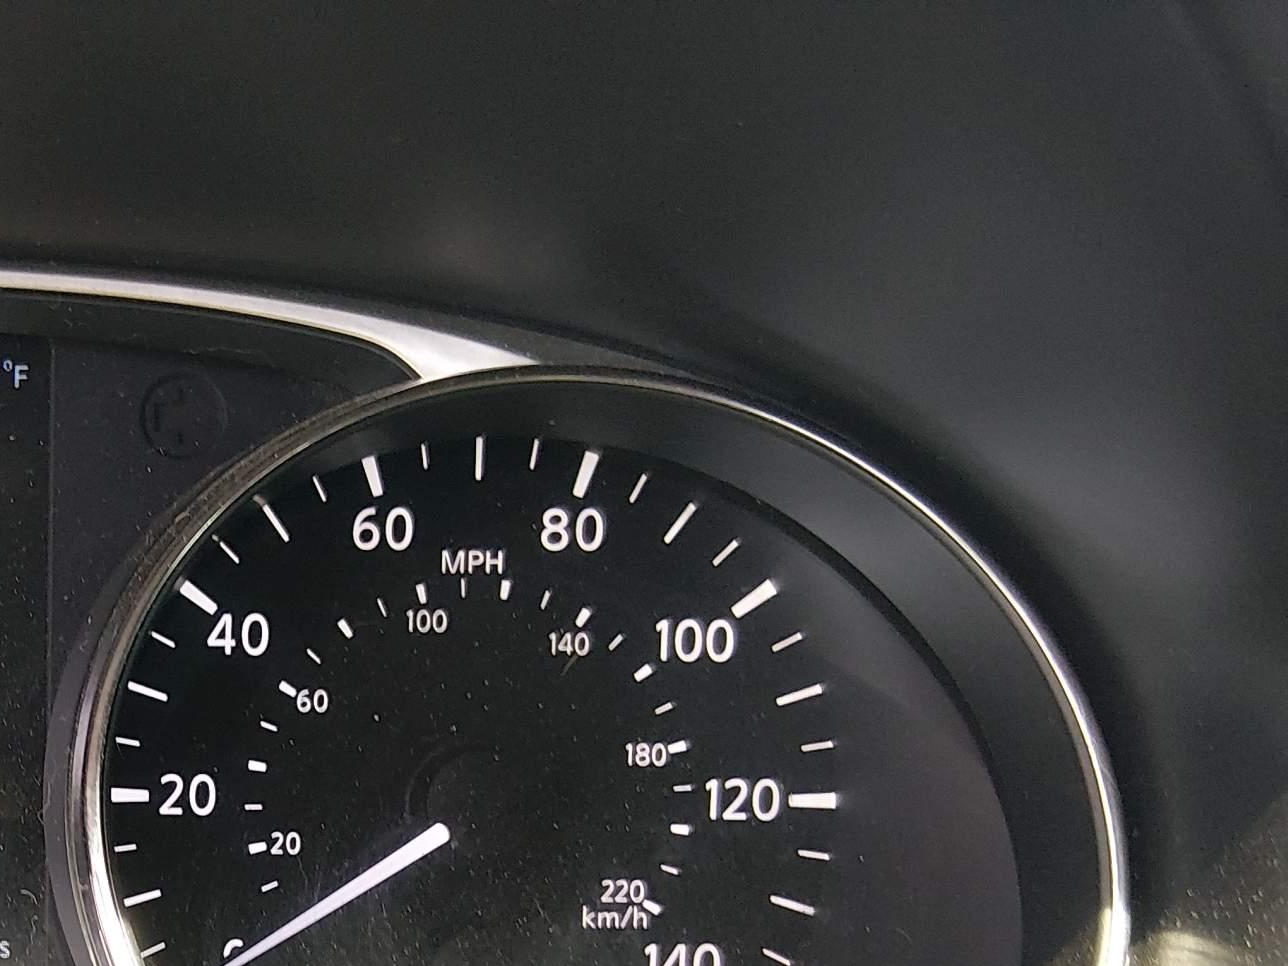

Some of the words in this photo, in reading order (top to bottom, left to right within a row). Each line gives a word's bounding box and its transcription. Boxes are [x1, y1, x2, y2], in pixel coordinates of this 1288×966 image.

[352, 507, 414, 551] 60
[540, 507, 604, 552] 80
[441, 549, 504, 575] MPH
[207, 613, 269, 656] 40
[406, 609, 448, 634] 100
[549, 631, 590, 657] 140
[655, 618, 734, 662] 100
[296, 688, 329, 714] 60
[625, 742, 667, 767] 180
[158, 774, 216, 816] 20
[705, 778, 780, 822] 120
[270, 831, 301, 856] 20
[600, 879, 644, 904] 220
[582, 905, 648, 931] km/h
